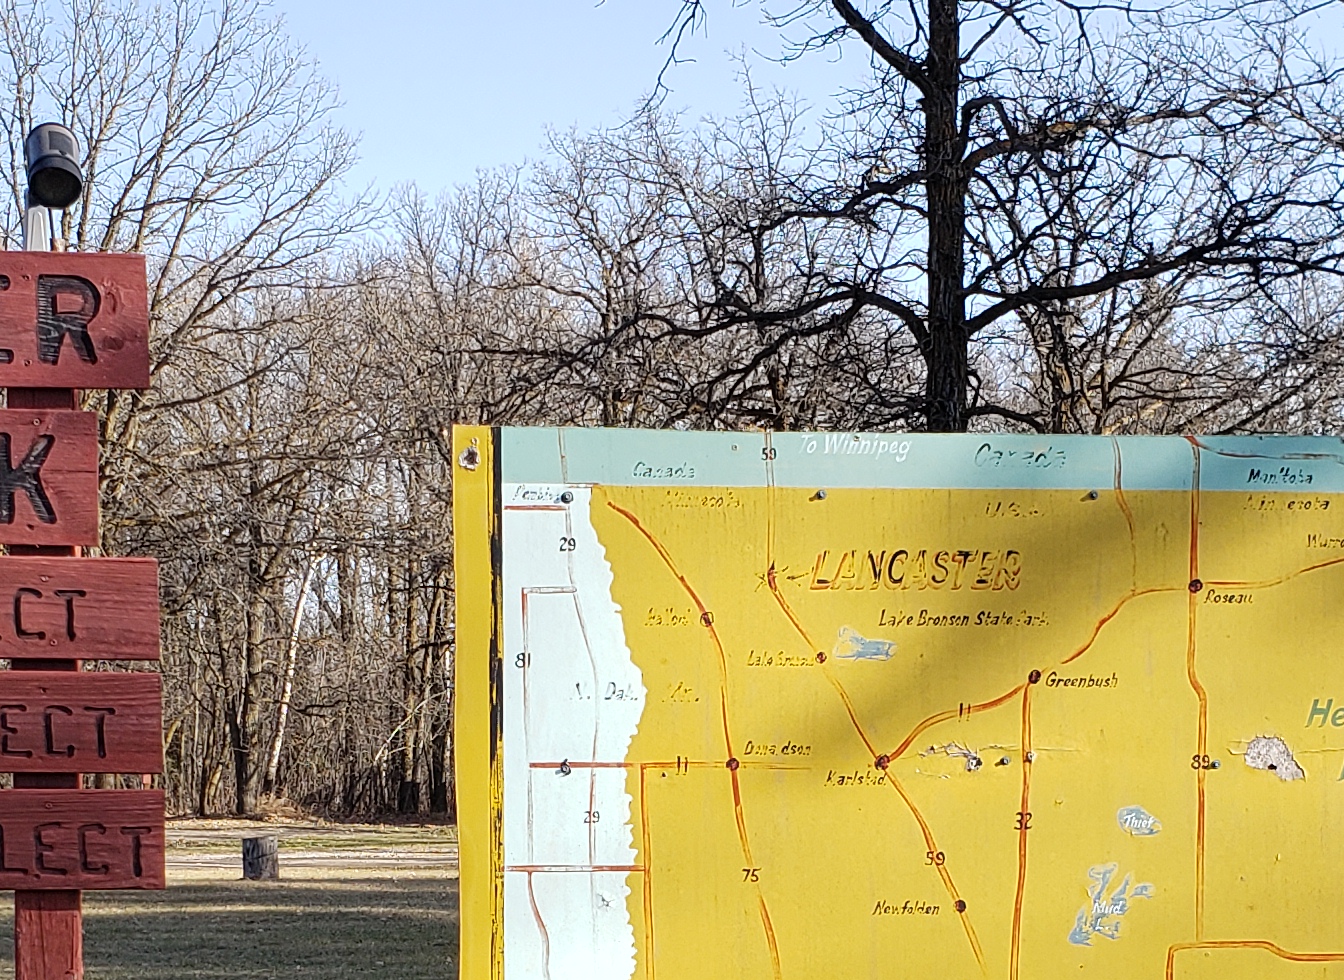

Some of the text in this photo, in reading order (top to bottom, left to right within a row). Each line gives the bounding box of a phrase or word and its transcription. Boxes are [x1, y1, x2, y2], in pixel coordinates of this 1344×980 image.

[800, 434, 912, 462] To Winnipeg
[1243, 495, 1330, 511] inesota
[559, 537, 576, 552] 29
[810, 550, 1021, 590] LANCASTER
[1203, 588, 1253, 604] Roseau
[878, 609, 913, 627] Lake
[917, 609, 969, 627] Bronson
[974, 609, 1013, 626] State
[515, 652, 531, 668] 81
[1045, 671, 1118, 688] Greenbush
[1191, 754, 1210, 770] 89
[583, 810, 600, 824] 29
[1014, 812, 1033, 830] 32
[1124, 813, 1155, 828] Thief
[924, 851, 945, 866] 59
[742, 868, 760, 883] 75
[1092, 900, 1122, 914] Mud
